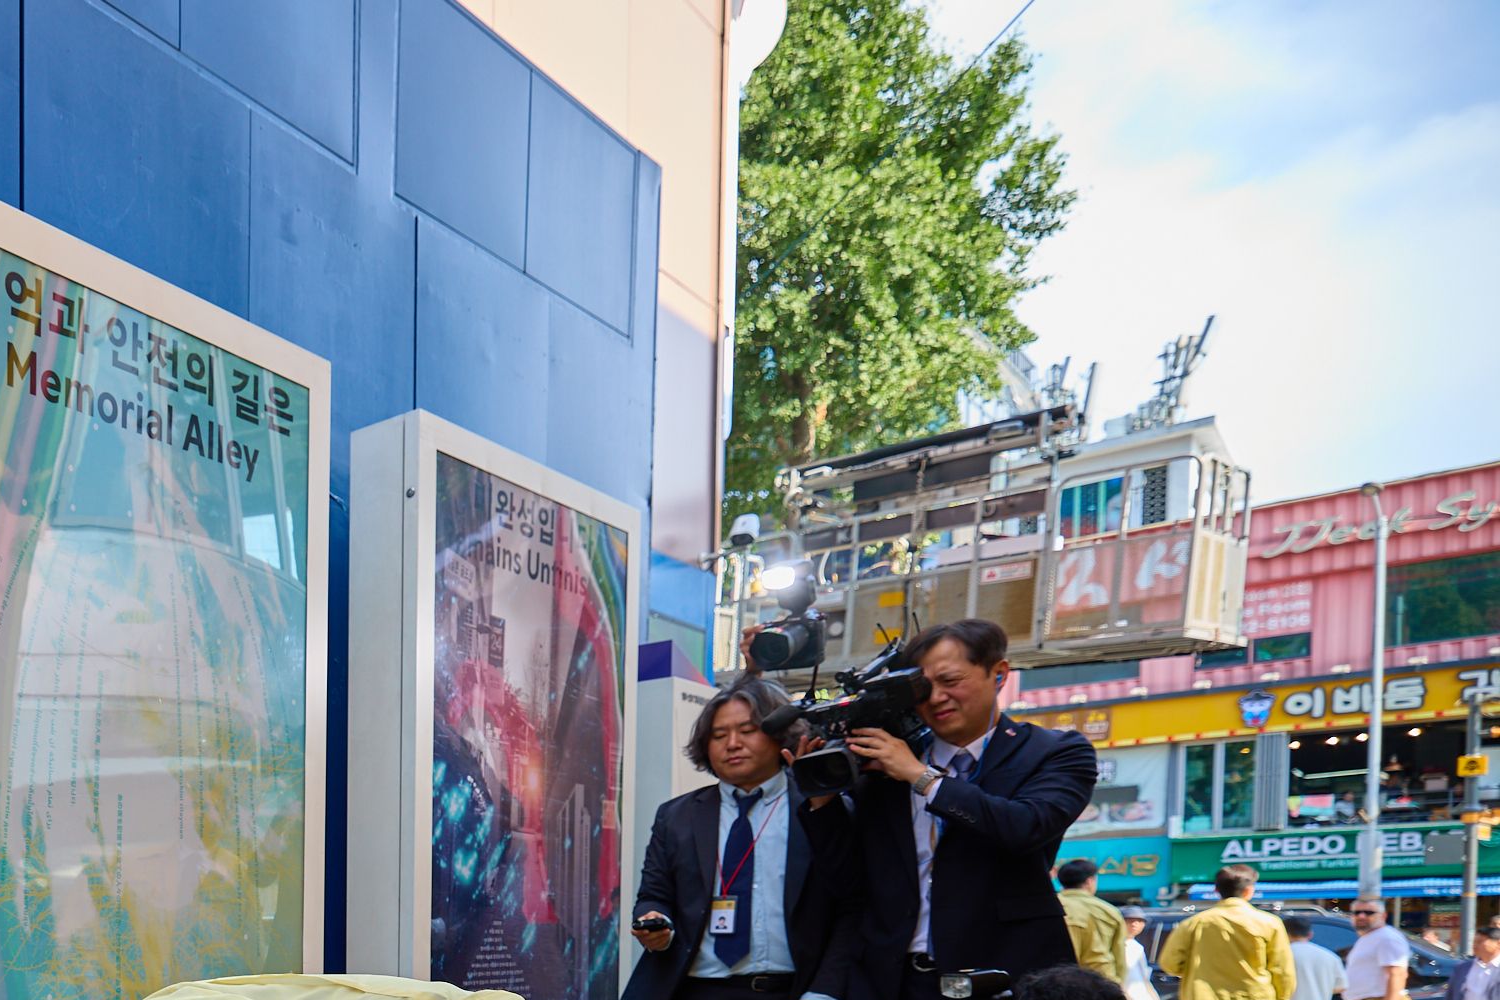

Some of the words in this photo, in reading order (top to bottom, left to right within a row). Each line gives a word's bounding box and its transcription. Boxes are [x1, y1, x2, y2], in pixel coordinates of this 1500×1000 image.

[6, 341, 173, 445] Memorial
[182, 414, 259, 482] Alley
[107, 316, 214, 407] 안전의
[231, 368, 294, 437] 길은
[1221, 834, 1346, 858] ALPEDO
